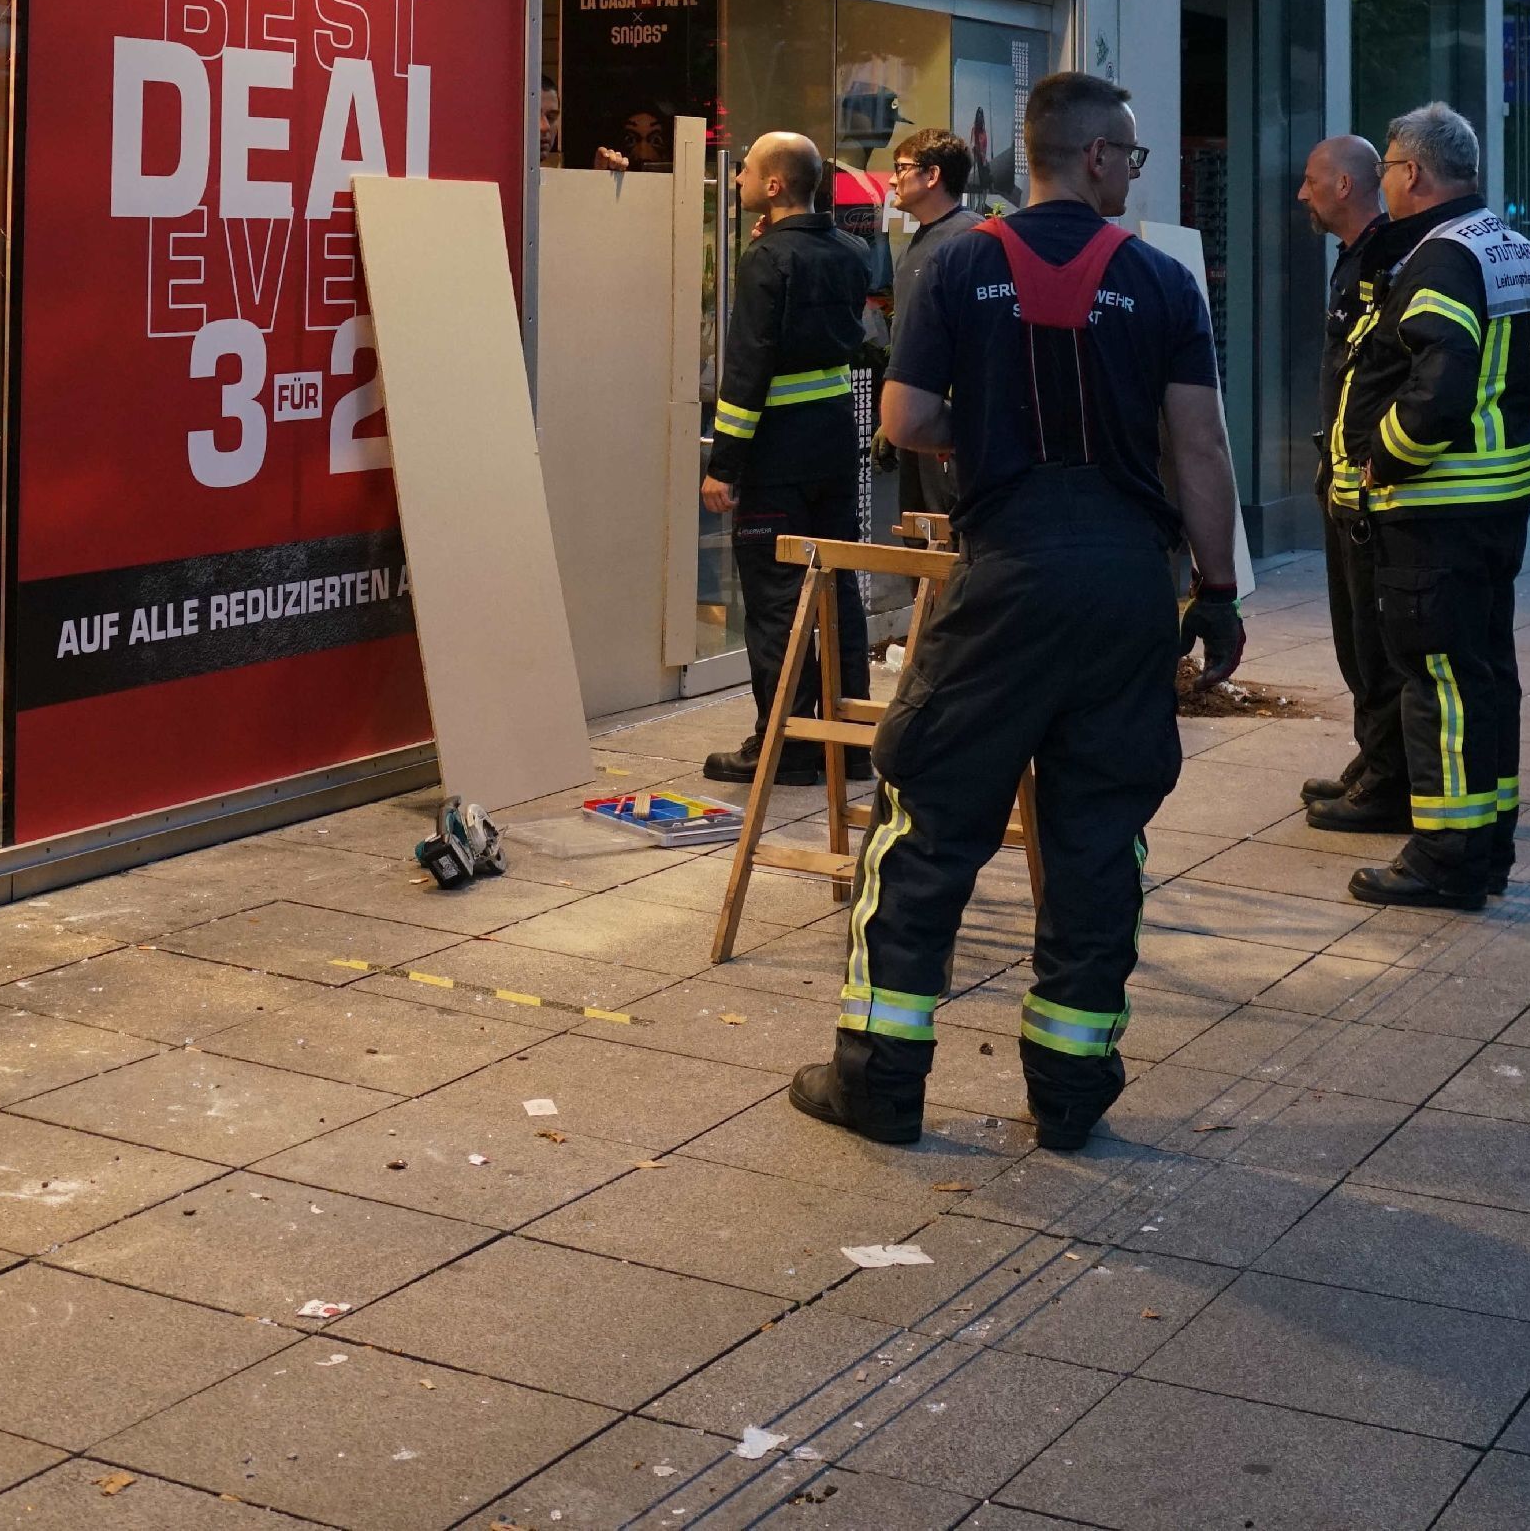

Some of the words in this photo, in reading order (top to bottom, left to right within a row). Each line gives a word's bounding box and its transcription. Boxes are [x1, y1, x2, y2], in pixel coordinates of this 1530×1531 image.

[611, 24, 662, 48] snipes
[187, 319, 267, 488] 3
[278, 378, 319, 412] FÜR
[329, 315, 393, 474] 2
[864, 454, 872, 532] TWENTY
[57, 611, 119, 658] AUF
[129, 598, 199, 646] ALLE
[210, 567, 390, 632] REDUZIERTEN
